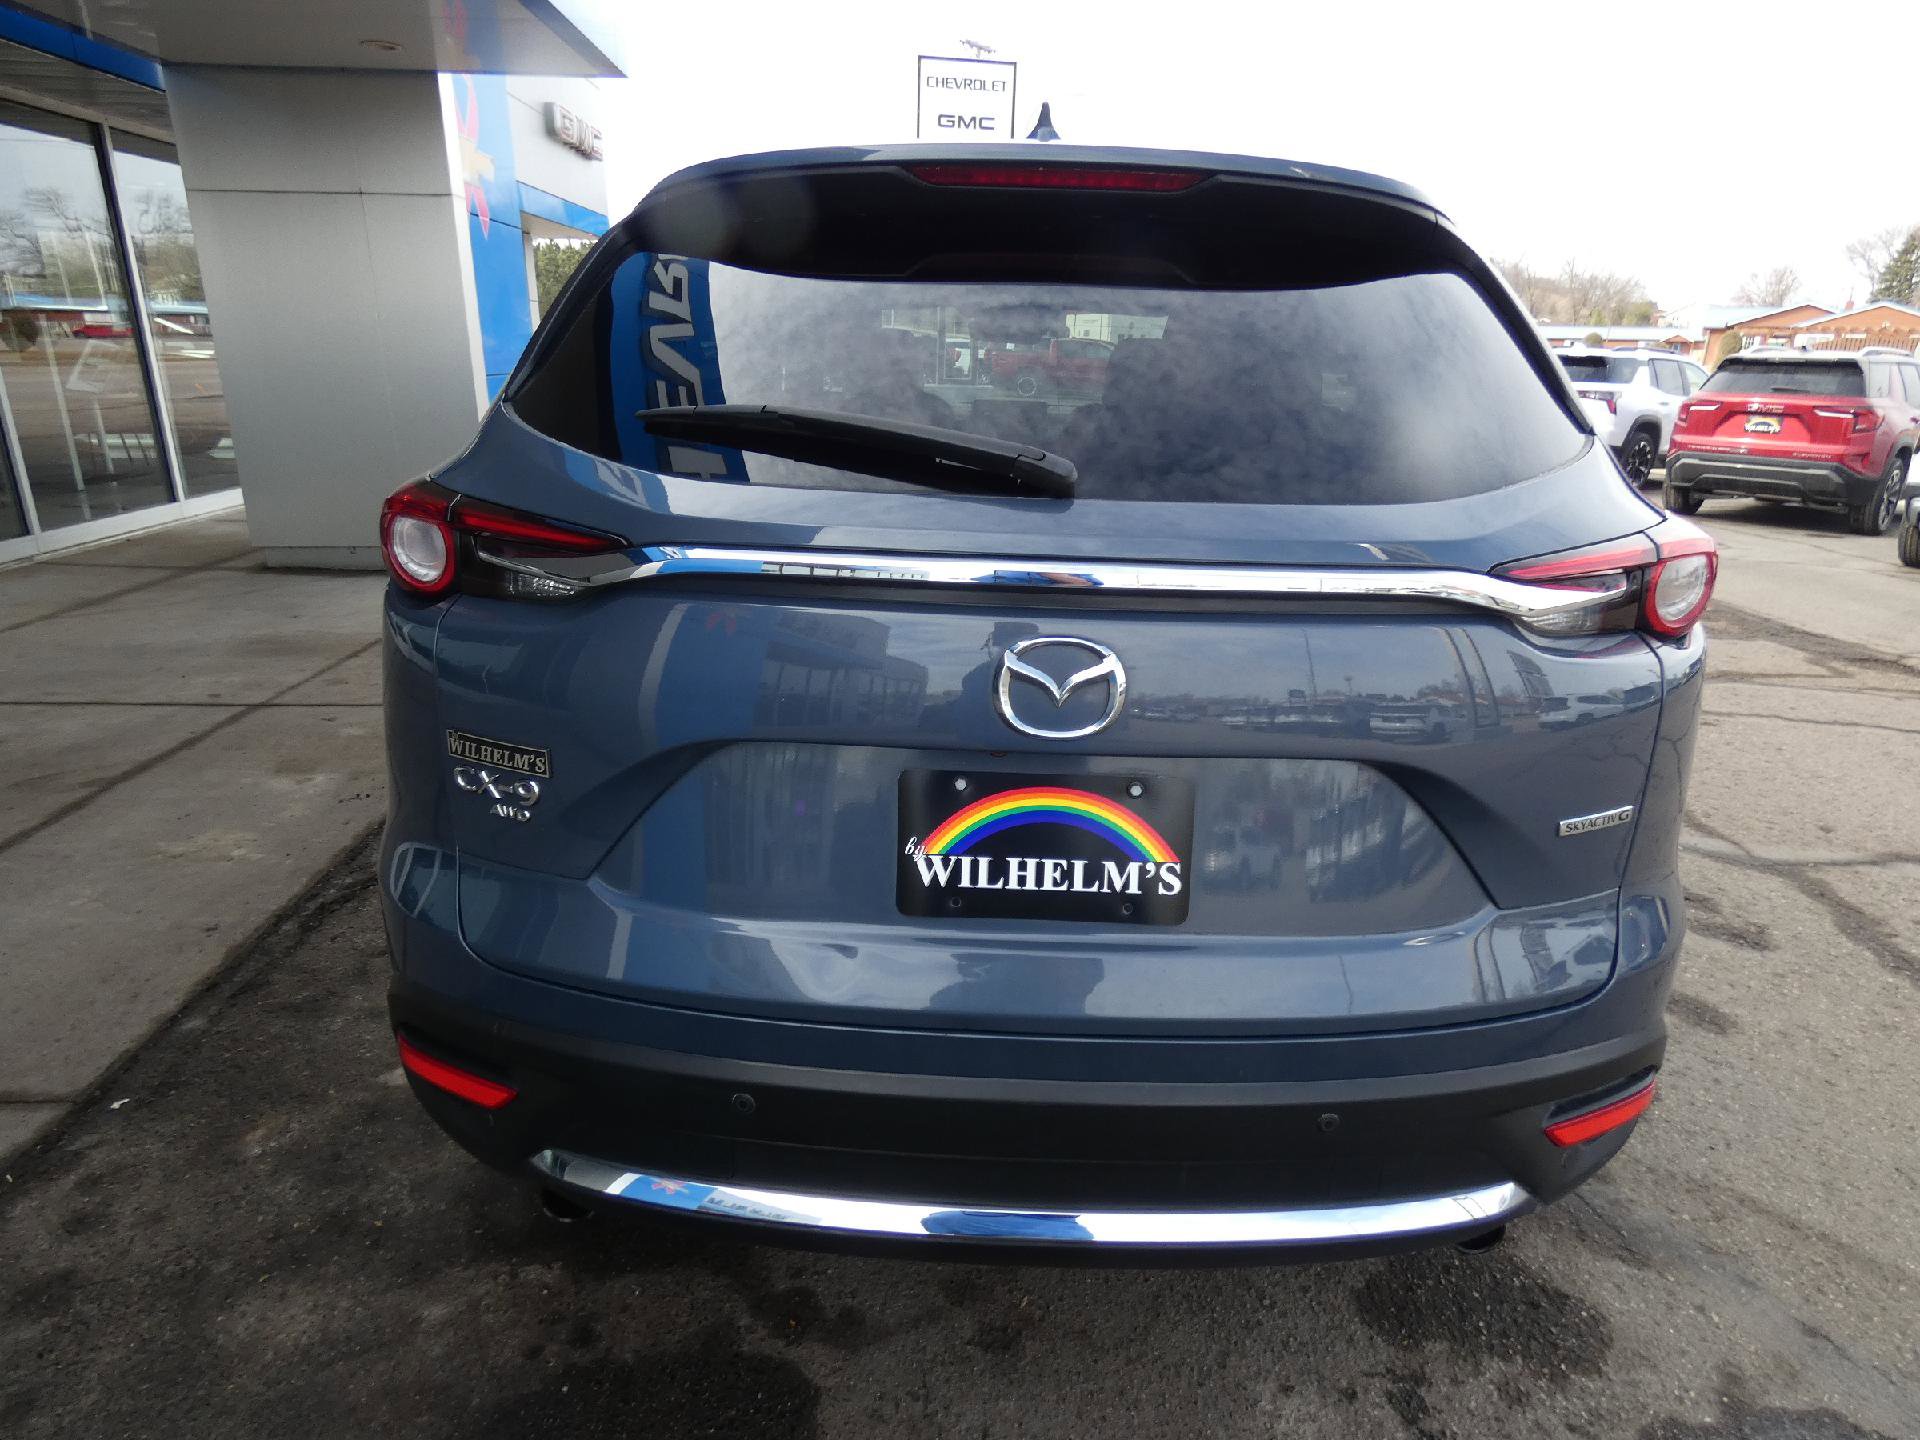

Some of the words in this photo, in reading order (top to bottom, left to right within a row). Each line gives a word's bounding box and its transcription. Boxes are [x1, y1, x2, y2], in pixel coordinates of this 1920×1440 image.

[926, 76, 1006, 92] CHEVROLET
[937, 114, 995, 131] GMC
[449, 738, 545, 773] WILHELM'S
[454, 767, 539, 806] CX-9
[905, 836, 928, 861] by
[913, 855, 1183, 896] WILHELM'S
